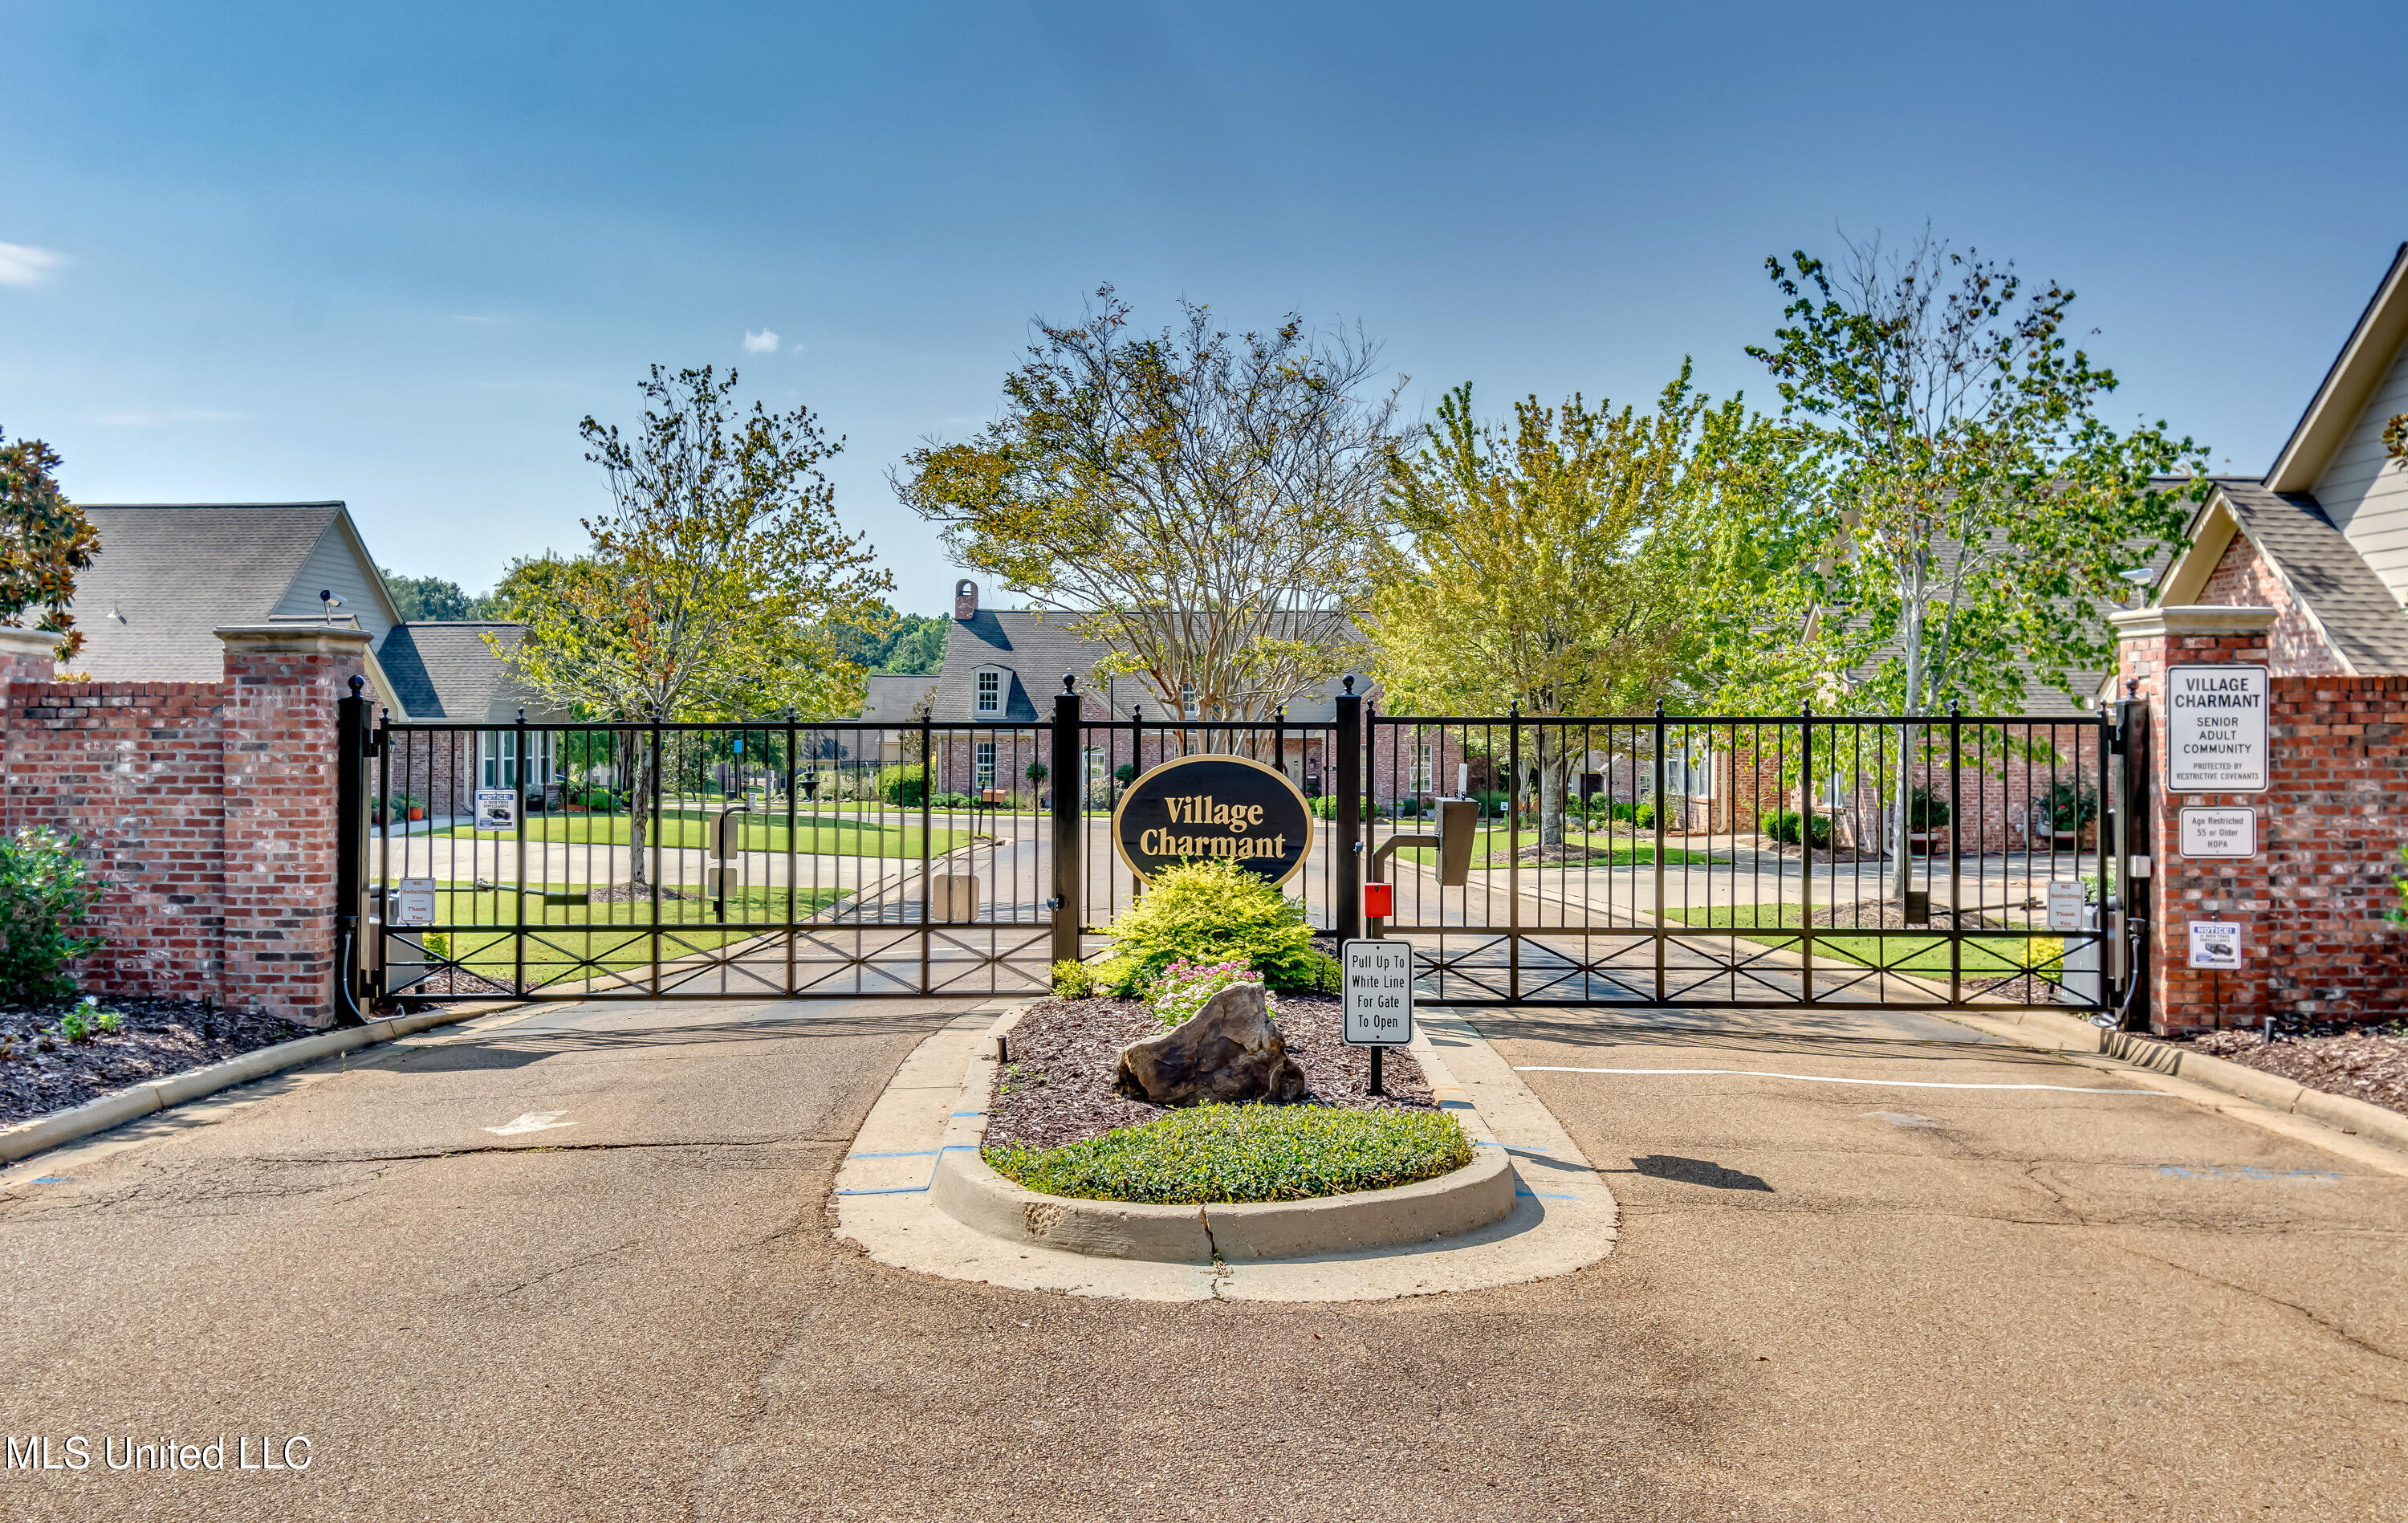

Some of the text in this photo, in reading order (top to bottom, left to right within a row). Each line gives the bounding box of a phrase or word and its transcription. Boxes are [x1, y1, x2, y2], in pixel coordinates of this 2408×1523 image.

[2186, 678, 2249, 691] VILLAGE
[2174, 694, 2261, 708] CHARMANT
[2197, 717, 2239, 727] SENIOR
[2199, 731, 2236, 740] ADULT
[2183, 743, 2251, 754] COMMUNITY
[2176, 772, 2260, 780] RESTRICTIVE COVENANTS
[1165, 795, 1263, 833] Village
[2192, 816, 2243, 826] Age Restricted
[2197, 829, 2207, 837] 55
[2219, 829, 2238, 837] Older
[1140, 827, 1286, 859] Charmant
[2207, 841, 2228, 849] HOPA
[1352, 955, 1405, 971] Pull Up To
[1352, 975, 1405, 988] White Line
[1357, 996, 1399, 1008] For Gate
[1358, 1015, 1398, 1031] To Open
